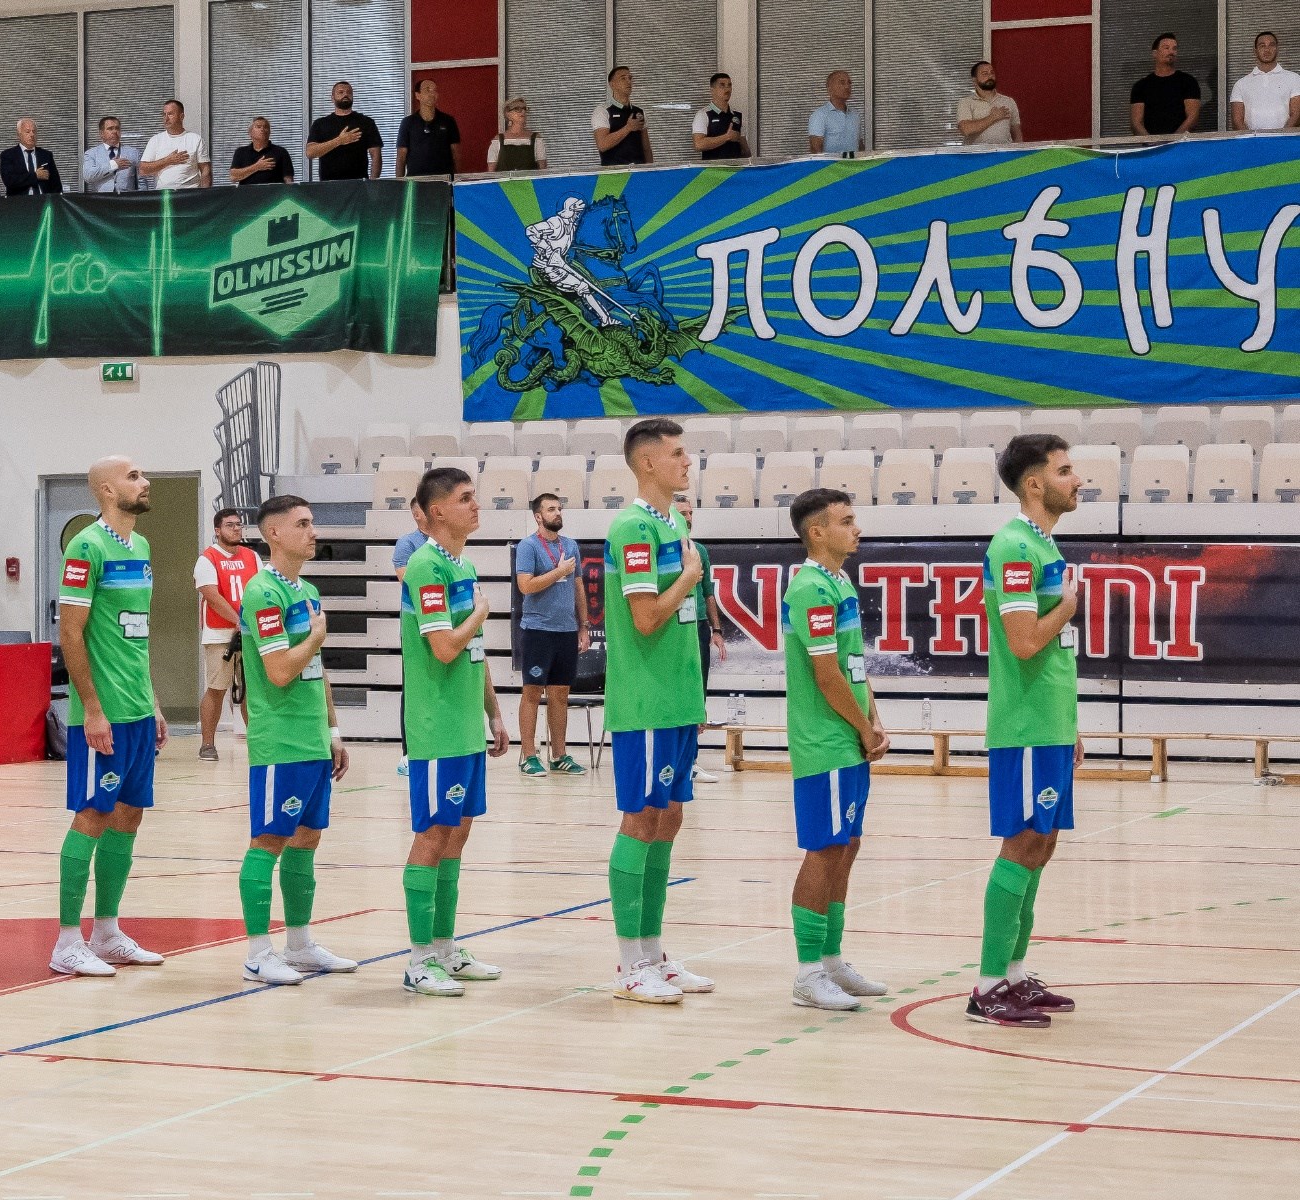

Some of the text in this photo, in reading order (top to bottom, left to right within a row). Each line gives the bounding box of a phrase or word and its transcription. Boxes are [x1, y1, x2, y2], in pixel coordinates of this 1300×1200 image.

[217, 239, 351, 296] OLMISSUM
[626, 551, 649, 559] Super
[628, 558, 648, 566] Sport
[1005, 569, 1031, 577] Super
[1006, 577, 1030, 585] Sport
[229, 574, 244, 601] 11
[422, 592, 443, 600] Super
[424, 599, 443, 607] Sport
[710, 563, 1206, 661] VTRNI
[810, 614, 833, 622] Super
[812, 621, 832, 630] Sport
